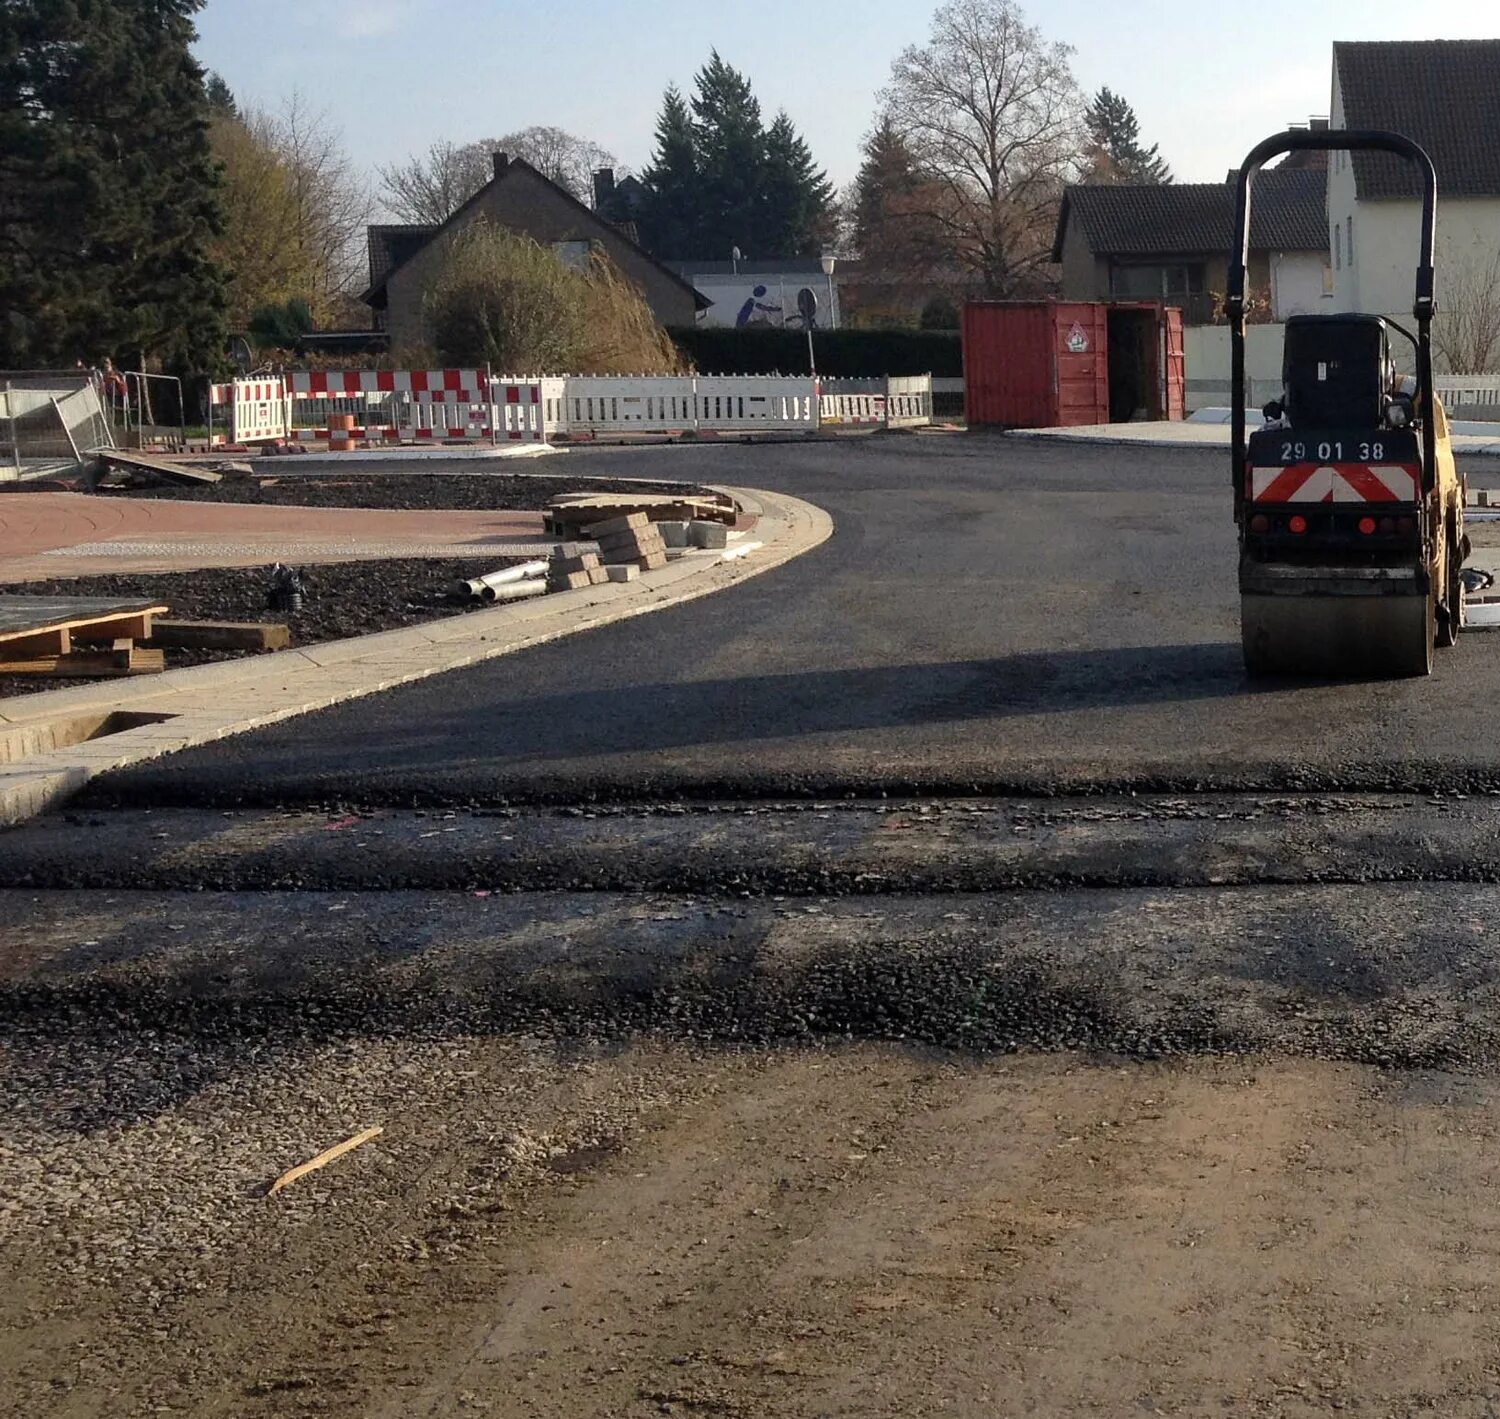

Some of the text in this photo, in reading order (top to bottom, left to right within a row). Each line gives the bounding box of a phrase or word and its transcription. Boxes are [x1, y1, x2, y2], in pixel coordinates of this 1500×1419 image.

[1281, 442, 1384, 460] 29 01 38
